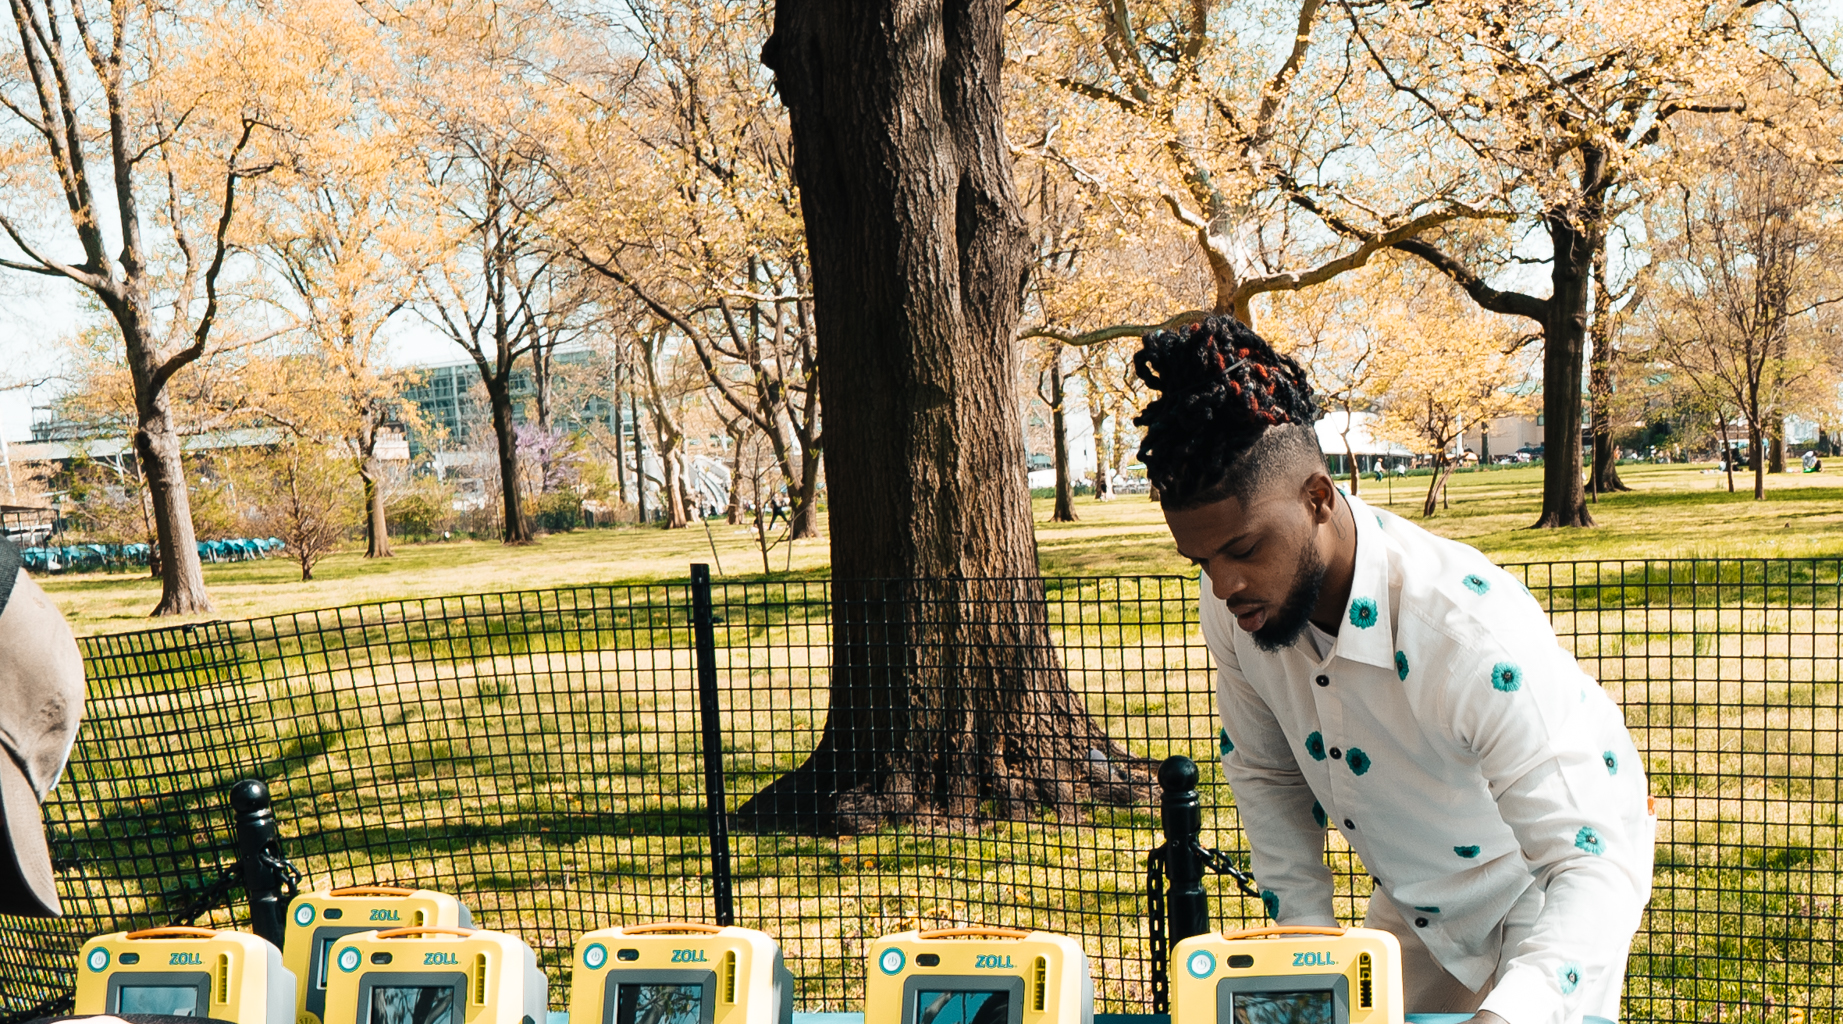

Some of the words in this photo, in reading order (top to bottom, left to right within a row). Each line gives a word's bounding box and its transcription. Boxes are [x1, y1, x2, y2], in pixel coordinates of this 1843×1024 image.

[369, 909, 400, 921] ZOLL
[169, 952, 202, 965] ZOLL
[423, 952, 458, 965] ZOLL
[671, 949, 707, 963] ZOLL
[975, 954, 1014, 968] ZOLL
[1292, 951, 1335, 967] ZOLL
